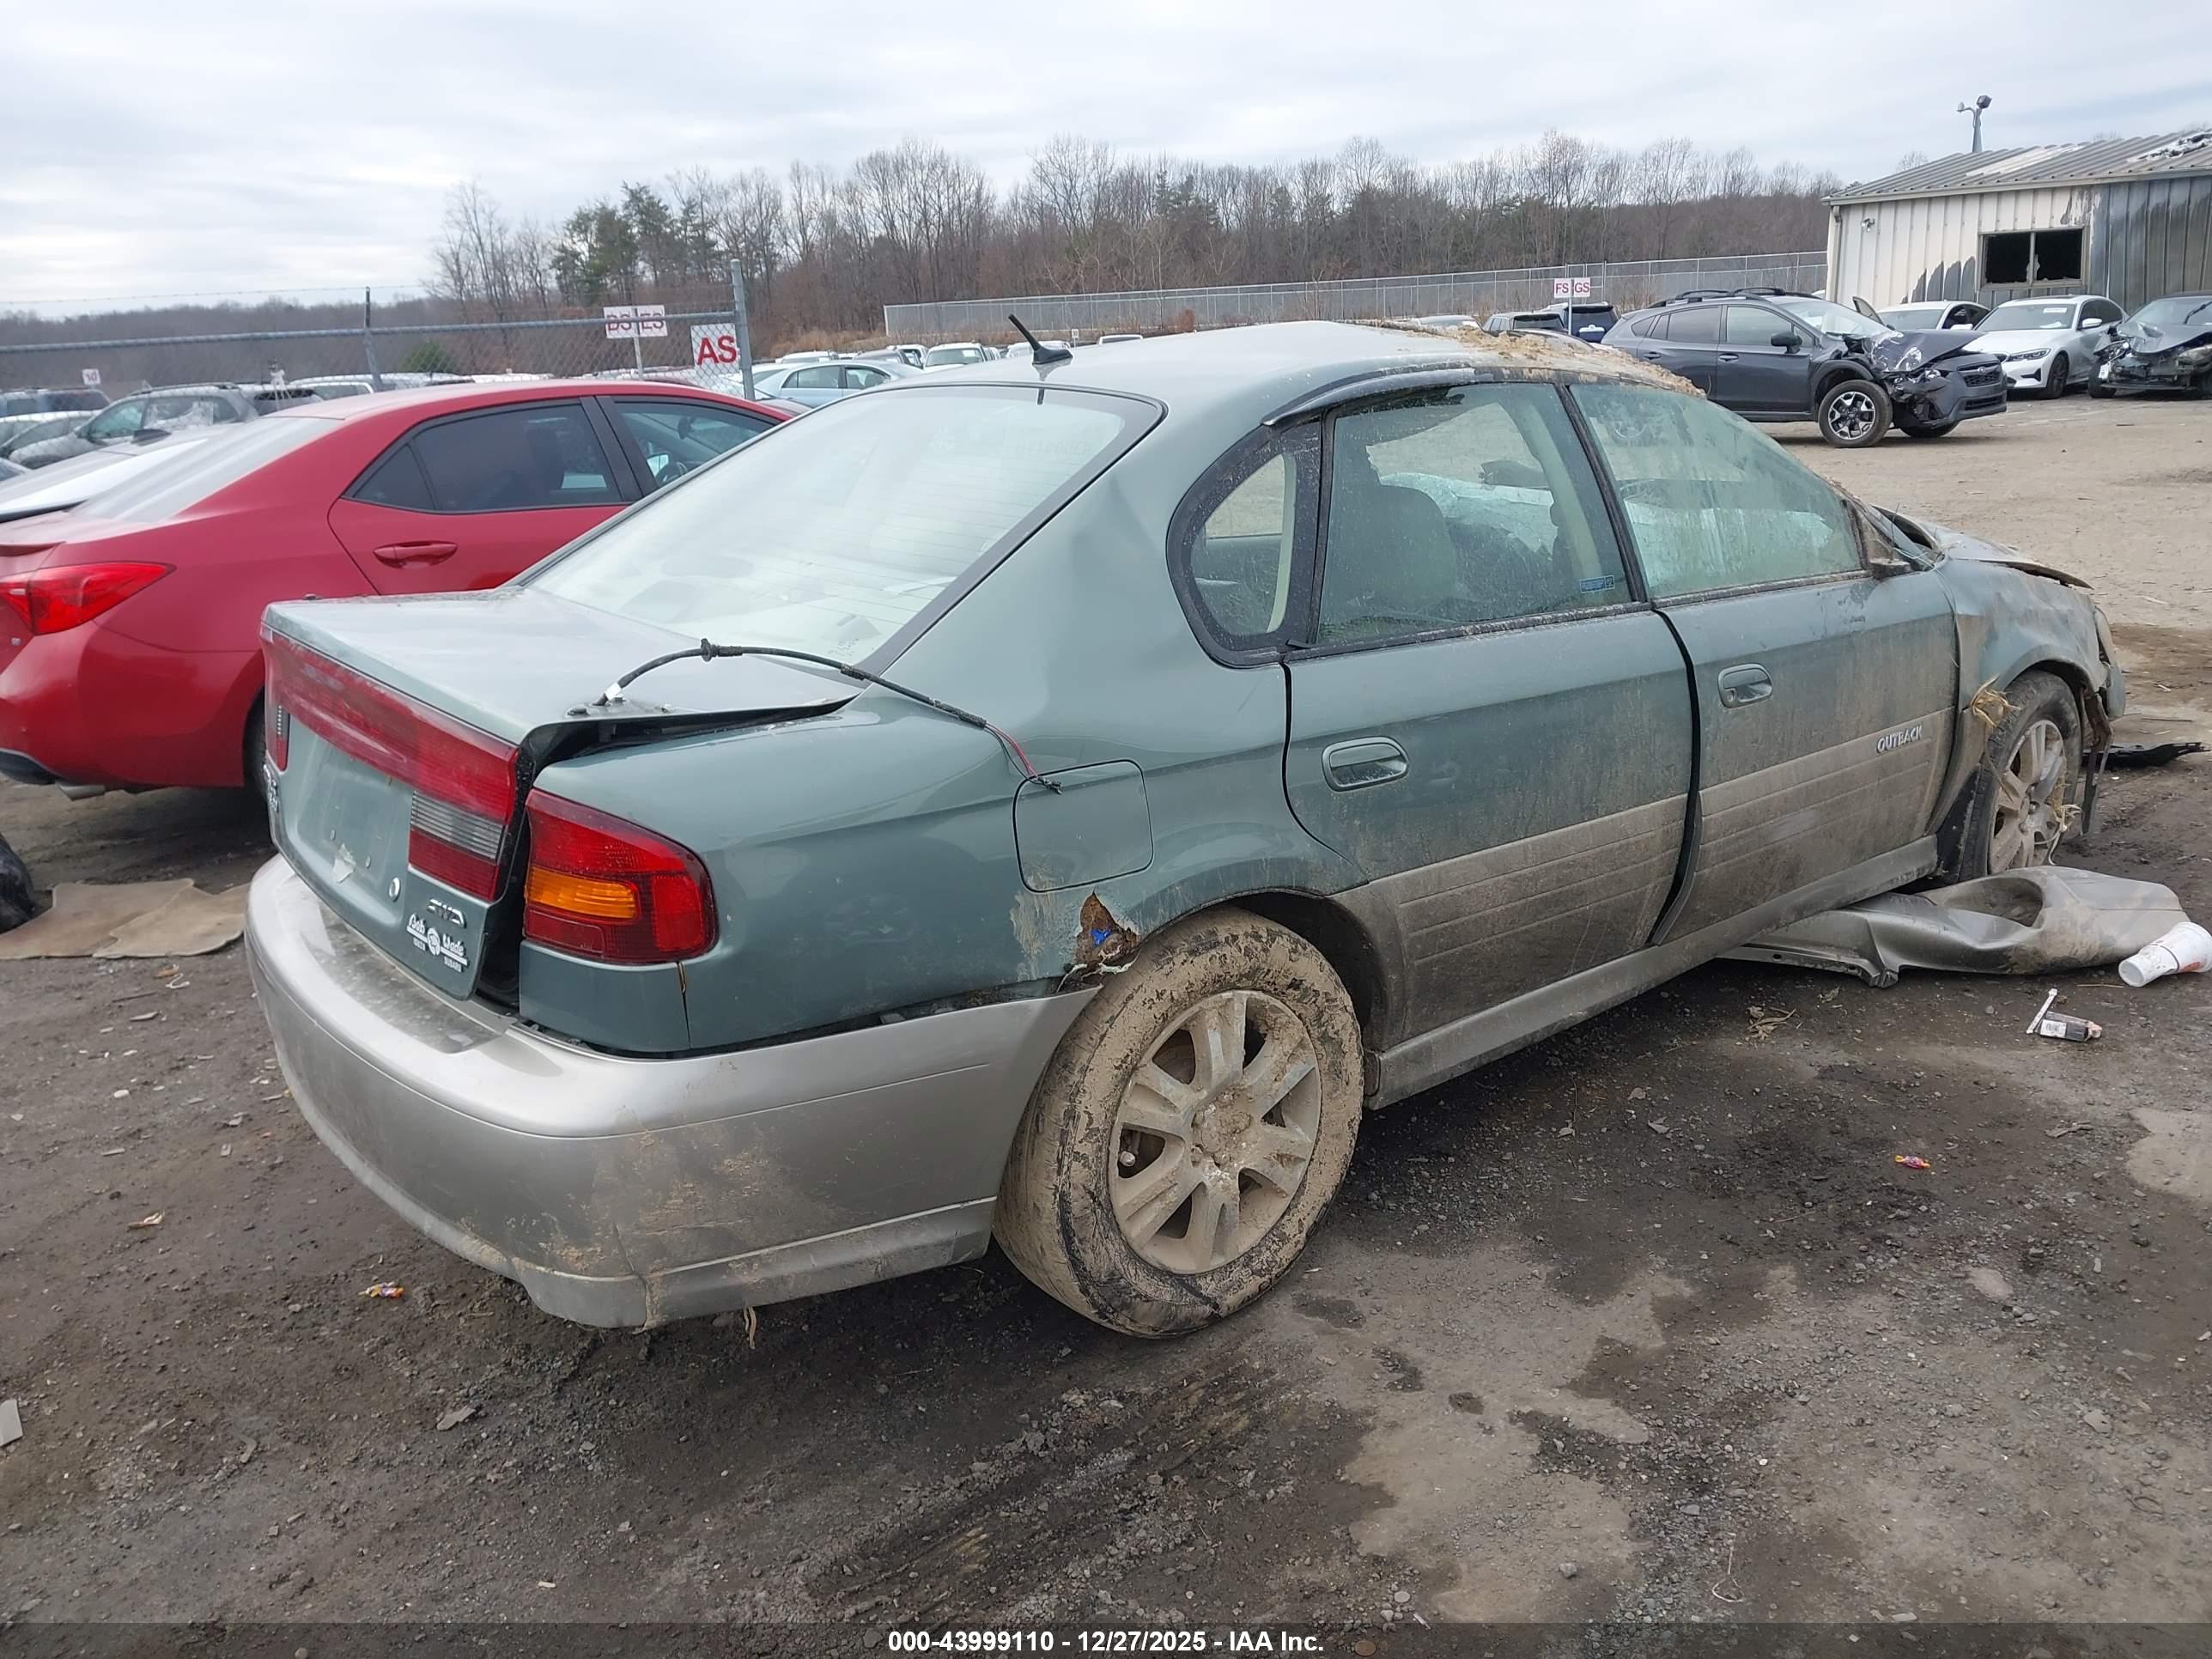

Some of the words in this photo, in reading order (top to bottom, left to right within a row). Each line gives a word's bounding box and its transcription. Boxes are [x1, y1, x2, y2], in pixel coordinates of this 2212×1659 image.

[1555, 283, 1569, 294] FS
[1574, 282, 1589, 293] GS
[696, 335, 738, 366] AS
[1876, 724, 1923, 753] OUTBACK
